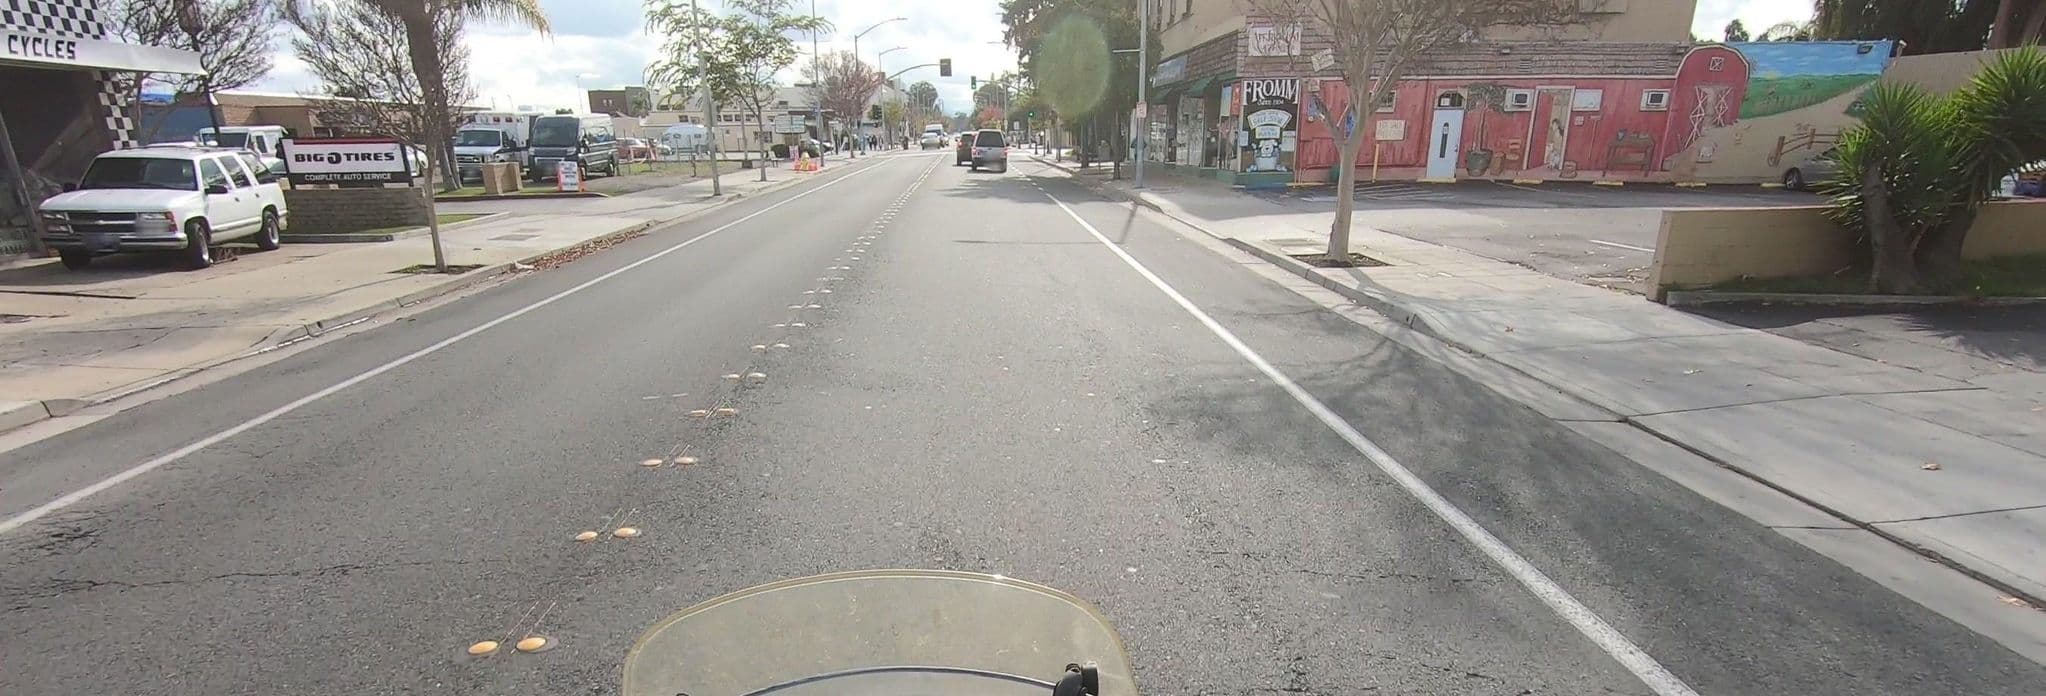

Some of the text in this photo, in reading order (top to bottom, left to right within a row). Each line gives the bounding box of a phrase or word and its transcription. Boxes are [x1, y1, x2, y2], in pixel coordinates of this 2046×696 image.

[8, 34, 76, 59] CYCLES
[1243, 79, 1300, 106] FROMM
[295, 152, 395, 165] BIG O TIRES
[304, 173, 341, 181] COMPLETE
[363, 172, 392, 180] SERVICE
